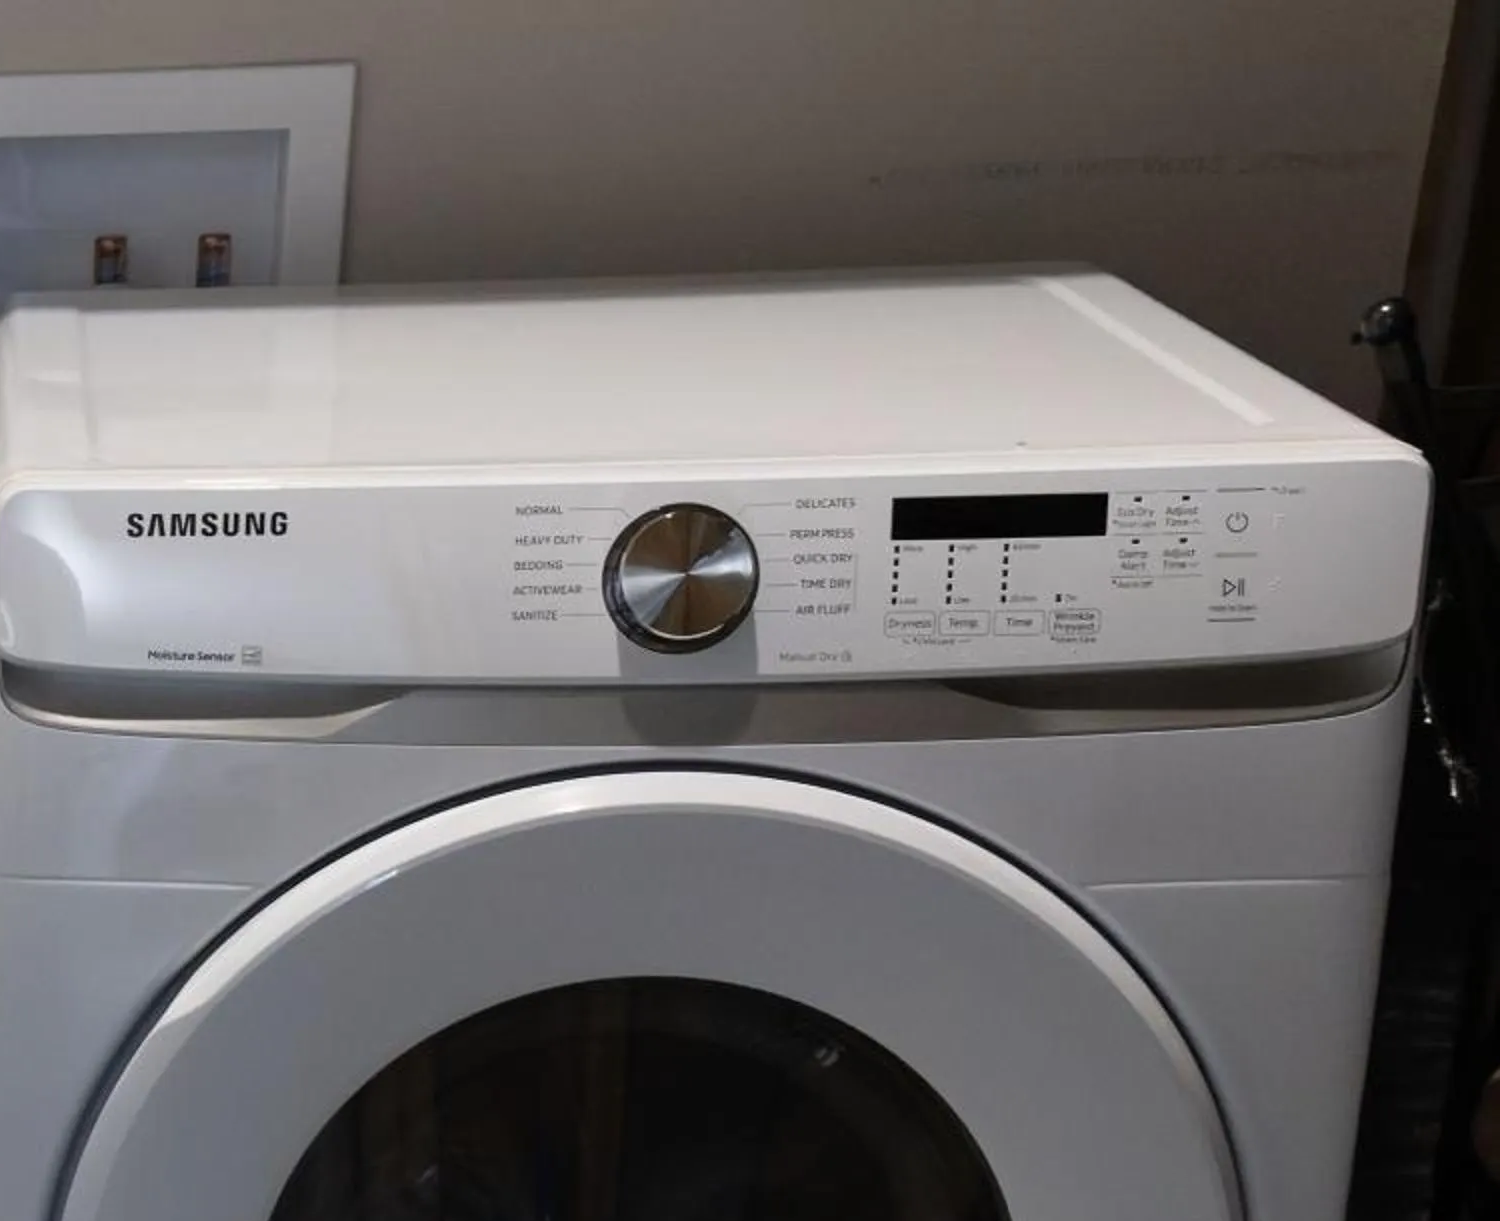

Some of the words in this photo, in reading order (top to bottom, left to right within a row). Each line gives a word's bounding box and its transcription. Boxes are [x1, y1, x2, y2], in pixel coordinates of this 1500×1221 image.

[795, 497, 856, 509] DELICATES
[515, 505, 564, 516] NORMAL
[126, 511, 289, 538] SAMSUNG
[789, 529, 821, 539] PERM
[822, 528, 855, 539] PRESS
[515, 536, 552, 546] HEAVY
[553, 534, 584, 545] DUTY
[513, 559, 564, 571] BEDDING
[793, 553, 828, 565] QUICK
[830, 553, 853, 564] DRY
[800, 578, 826, 589] TIME
[829, 578, 852, 589] DRY
[512, 584, 583, 596] ACTIVEWEAR
[511, 609, 559, 621] SANITIZE
[795, 604, 815, 615] AIR
[817, 603, 852, 614] FLUFF
[888, 618, 932, 630] Dryness
[147, 649, 196, 662] Moisture
[197, 650, 236, 663] Sensor
